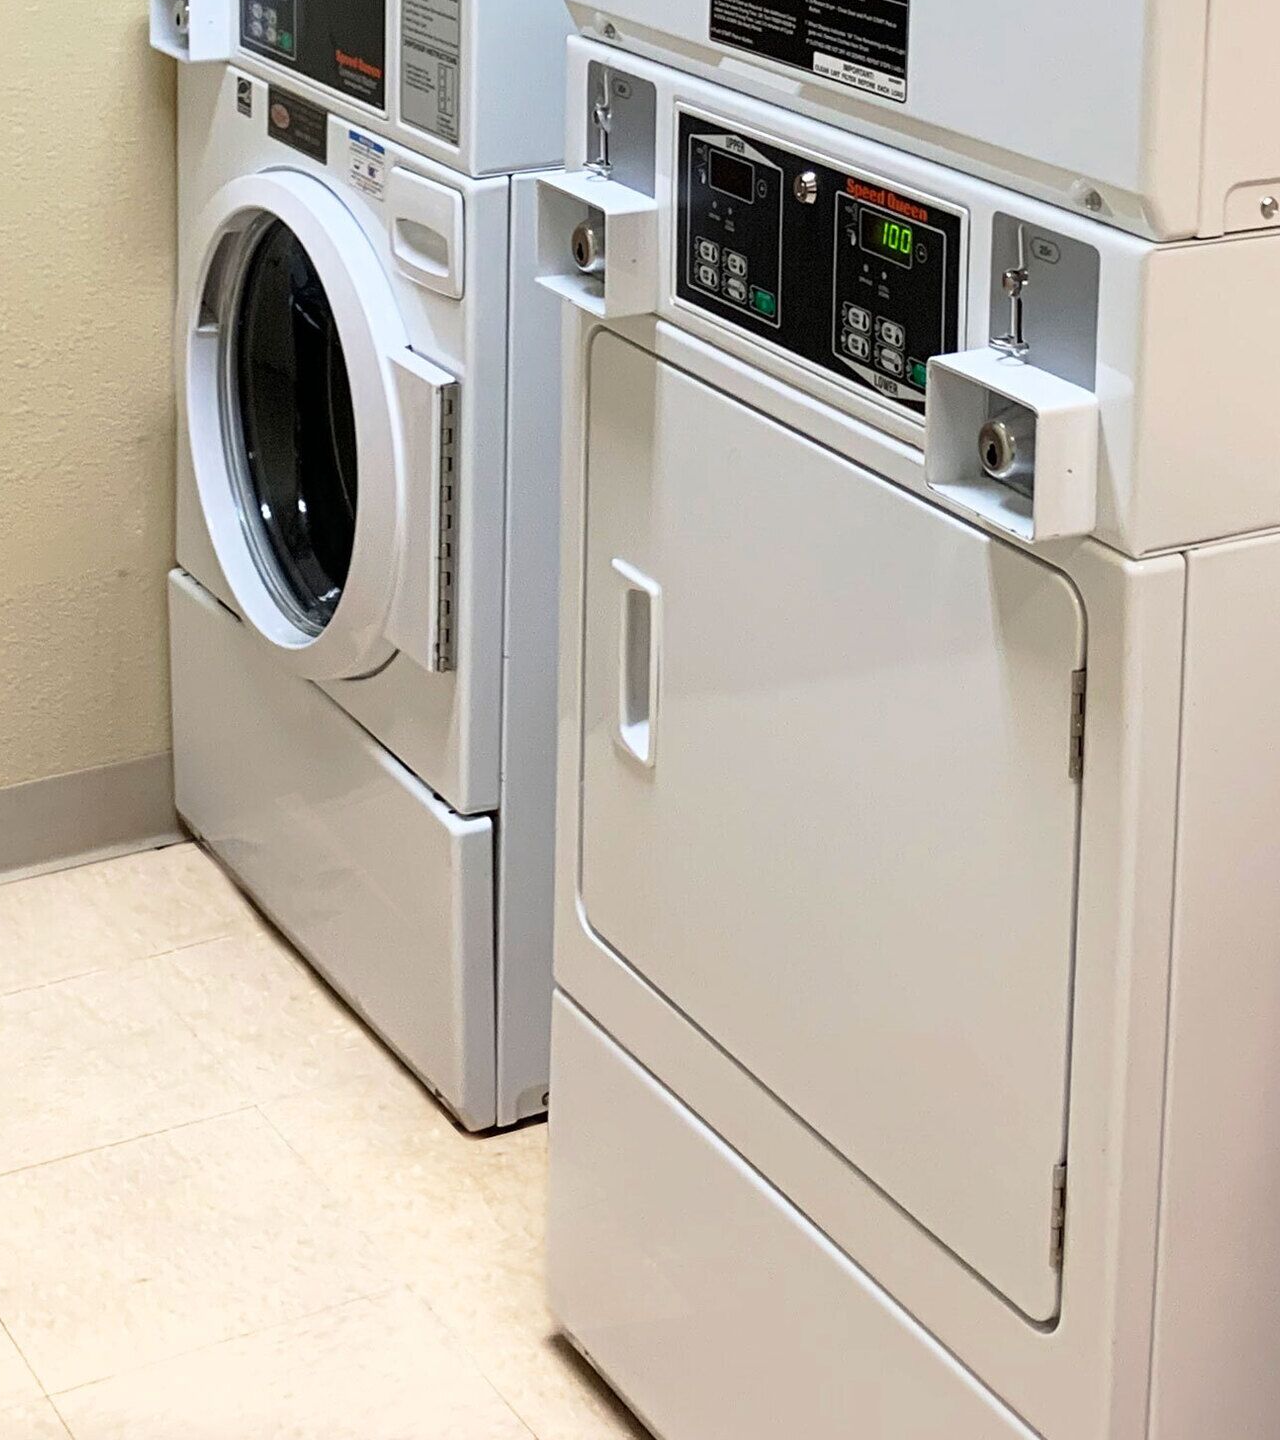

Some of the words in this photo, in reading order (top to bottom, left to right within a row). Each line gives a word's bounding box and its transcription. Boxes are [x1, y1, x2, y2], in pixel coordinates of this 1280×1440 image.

[858, 77, 875, 90] BEFORE
[877, 84, 890, 94] EACH
[725, 136, 745, 154] UPPER
[846, 177, 886, 206] Speed
[887, 193, 928, 222] Queen
[882, 222, 911, 254] 100
[873, 373, 898, 396] LOWER
